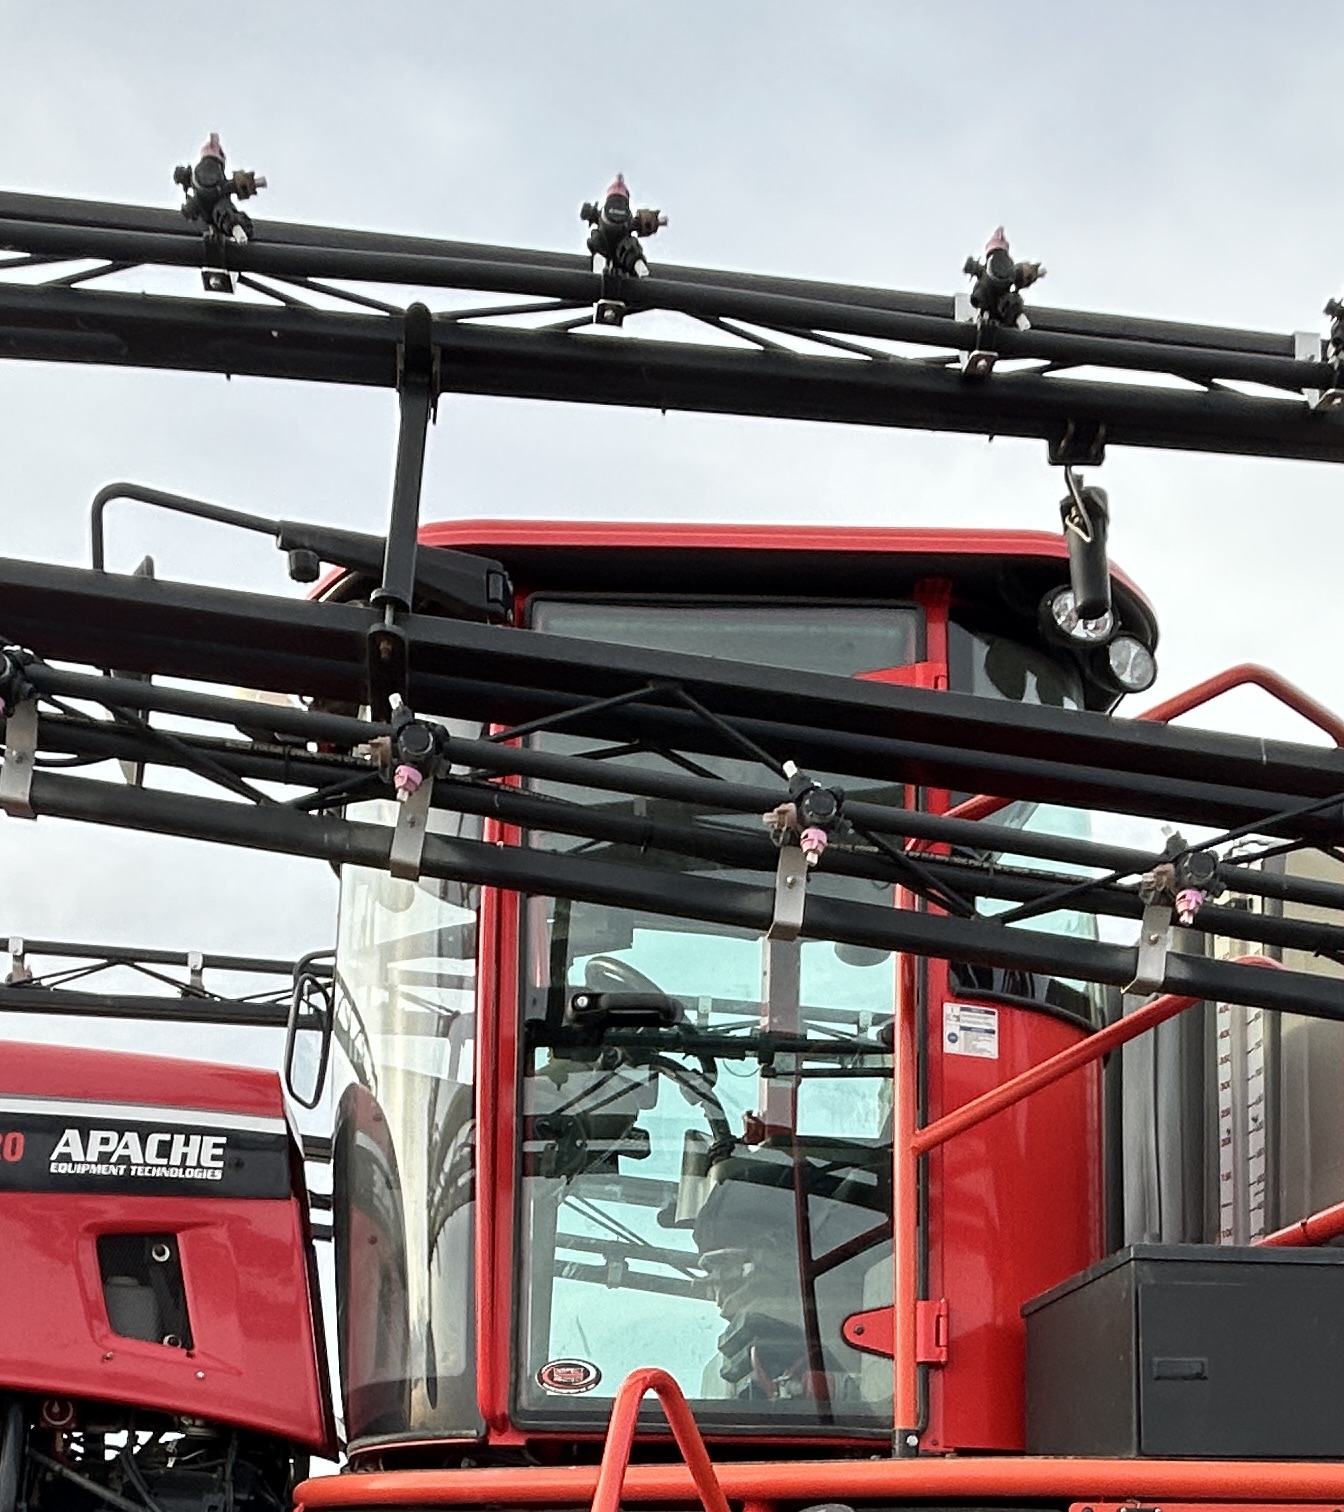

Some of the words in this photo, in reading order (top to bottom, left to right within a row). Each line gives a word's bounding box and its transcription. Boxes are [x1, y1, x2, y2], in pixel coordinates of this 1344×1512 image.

[49, 1128, 227, 1168] APACHE
[49, 1162, 126, 1176] EQUIPMENT
[130, 1165, 223, 1180] TECHNOLOGIES
